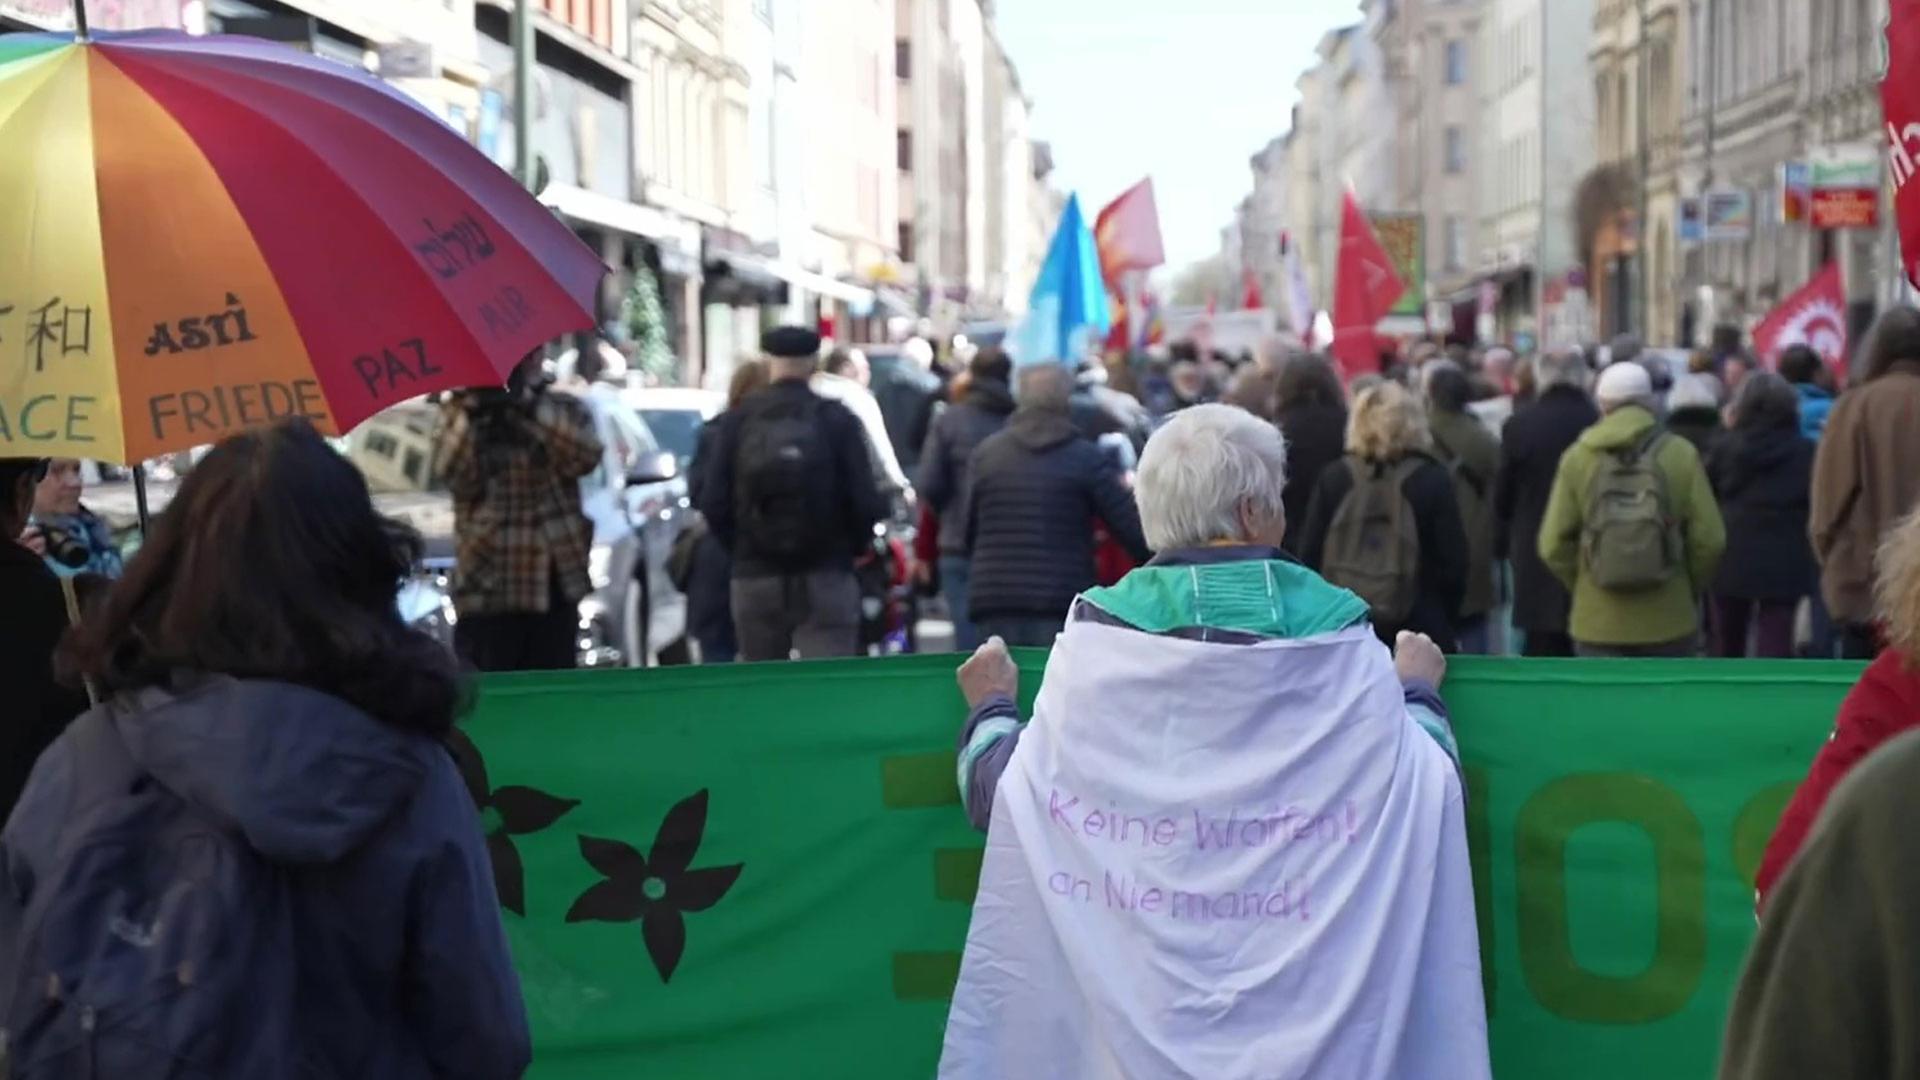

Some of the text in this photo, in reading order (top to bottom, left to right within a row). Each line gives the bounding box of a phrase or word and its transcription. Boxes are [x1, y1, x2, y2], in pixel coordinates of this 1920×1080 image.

[352, 337, 443, 399] PAZ
[149, 378, 328, 441] FRIEDE
[1050, 788, 1178, 846] Keine
[1050, 870, 1092, 901] an
